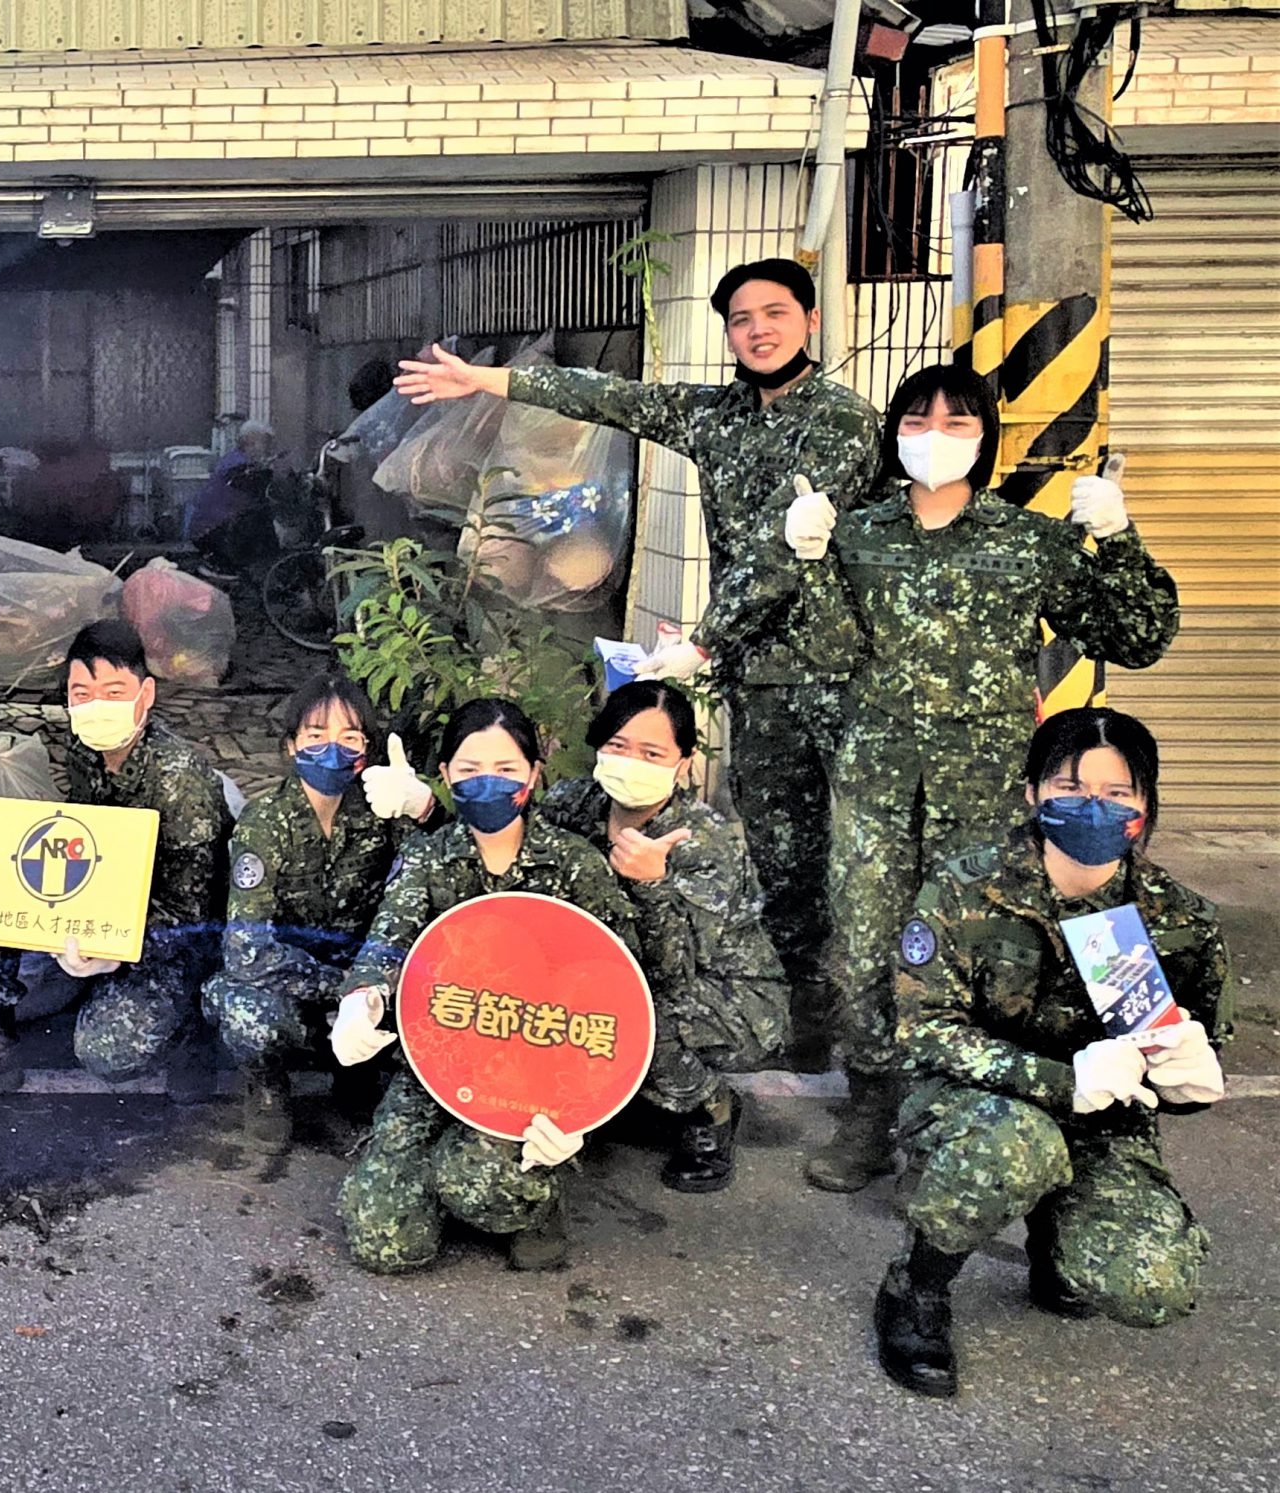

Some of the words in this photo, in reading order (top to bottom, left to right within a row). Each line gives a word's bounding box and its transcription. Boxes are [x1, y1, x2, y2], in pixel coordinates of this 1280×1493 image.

[40, 837, 84, 860] NRC
[429, 983, 617, 1060] 春節送暖
